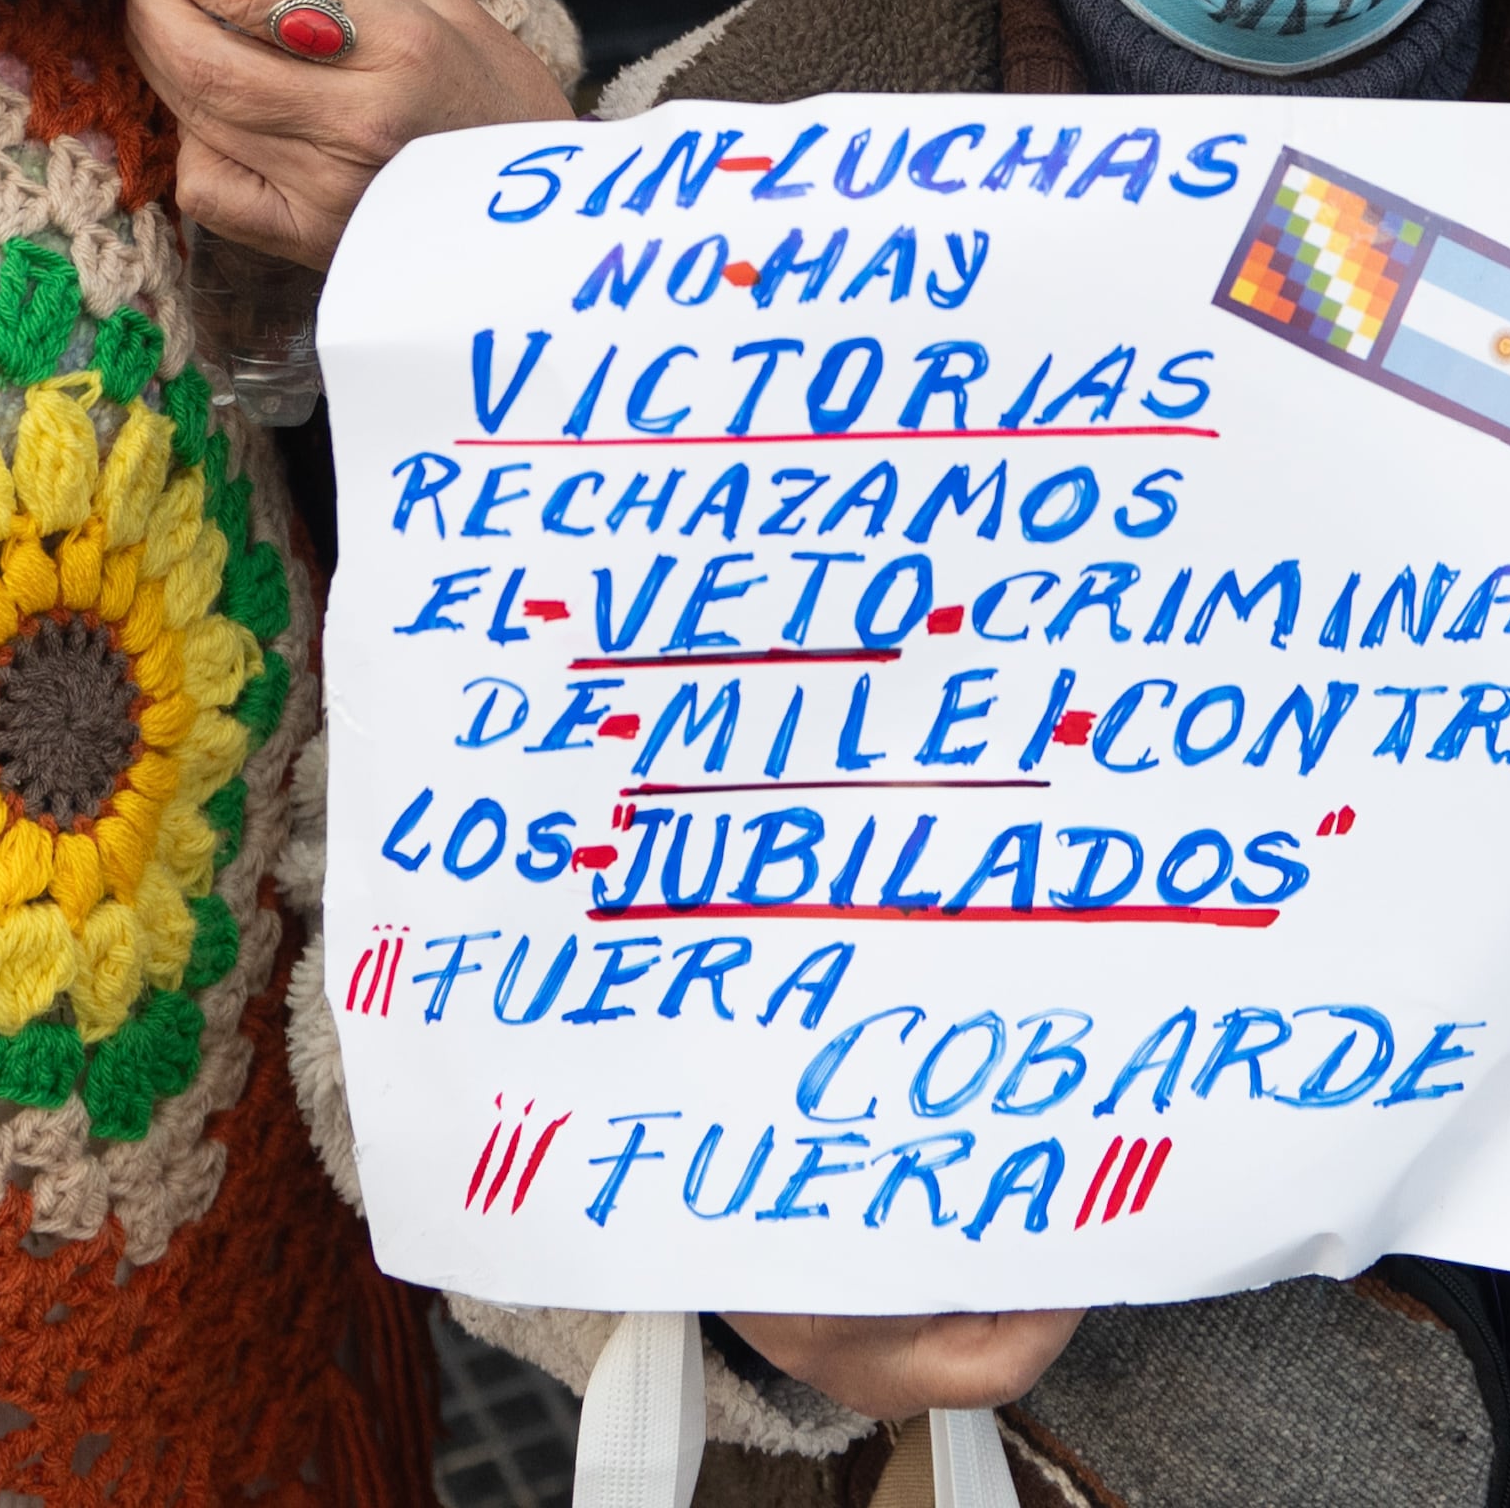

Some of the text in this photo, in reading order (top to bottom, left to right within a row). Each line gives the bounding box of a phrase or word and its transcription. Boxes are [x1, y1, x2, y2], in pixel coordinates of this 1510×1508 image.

[470, 327, 1217, 439] VICTORIAS
[391, 450, 1186, 545] RECHAZAMOS
[794, 1003, 1489, 1126] COBARDE
